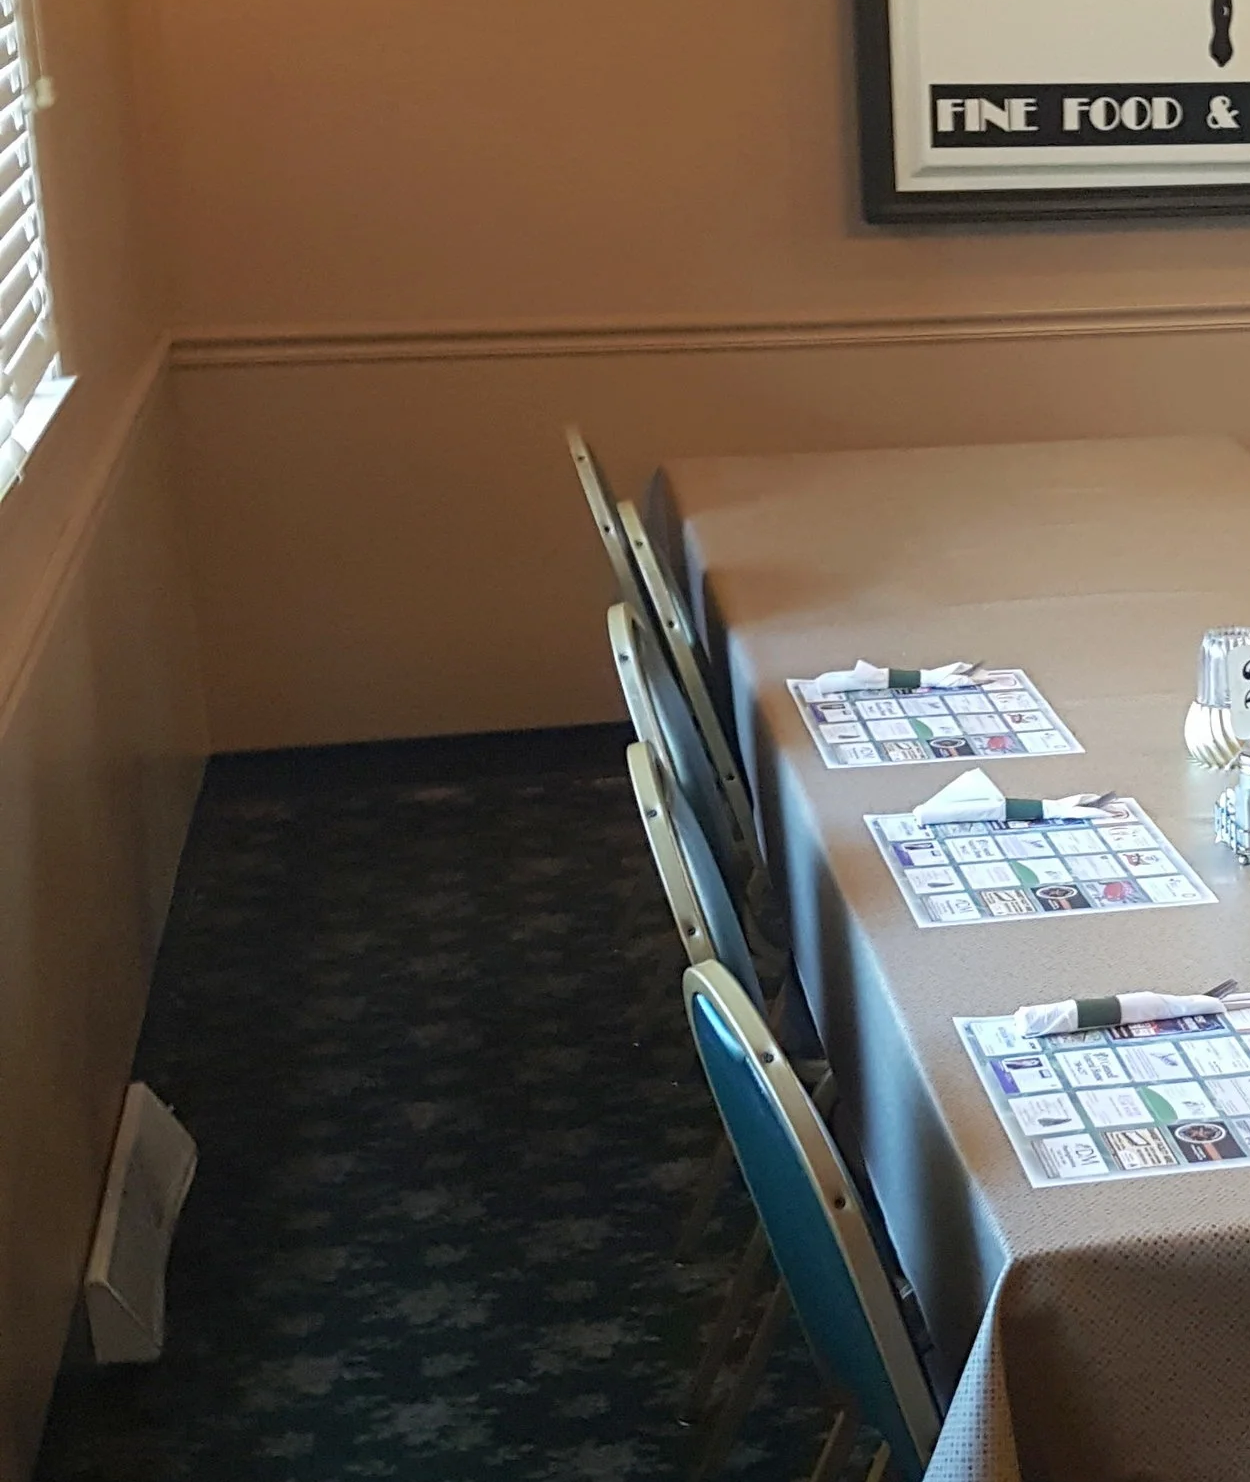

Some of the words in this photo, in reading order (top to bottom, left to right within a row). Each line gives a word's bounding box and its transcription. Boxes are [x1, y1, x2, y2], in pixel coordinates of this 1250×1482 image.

[936, 97, 1039, 132] FINE
[1063, 96, 1183, 131] FOOD
[1206, 95, 1240, 130] &
